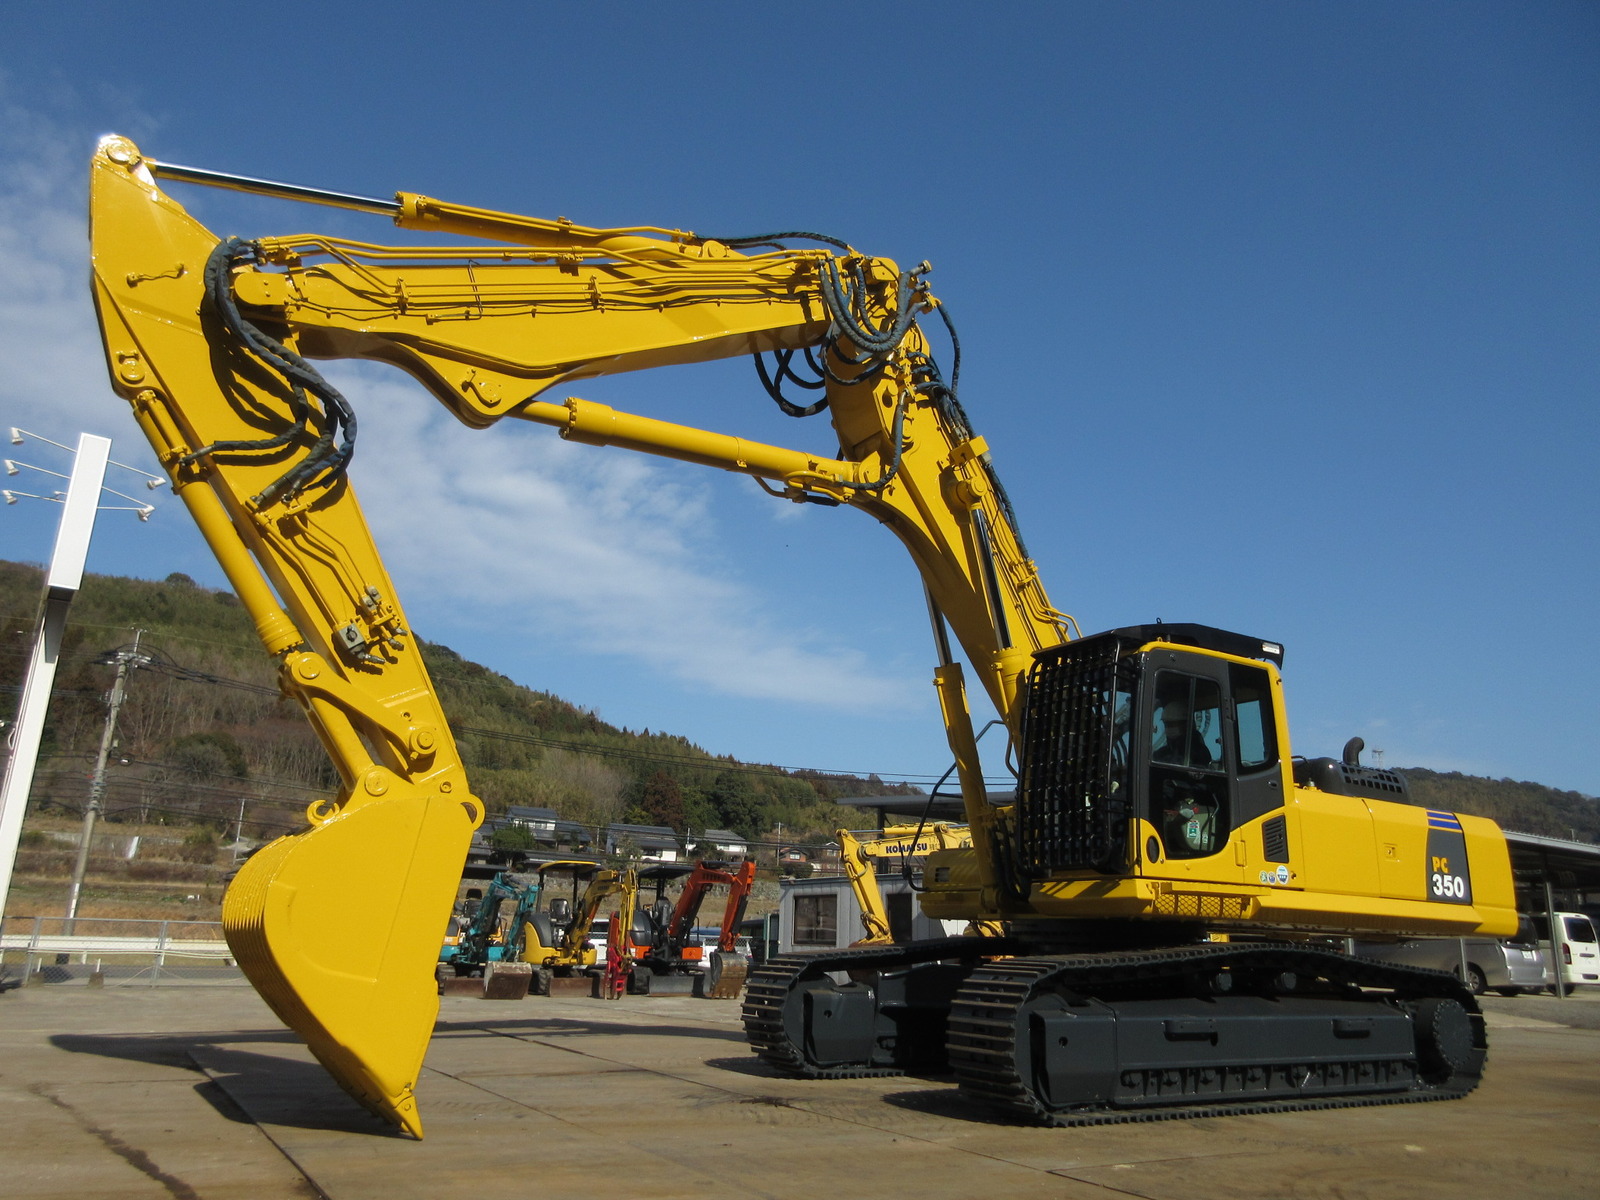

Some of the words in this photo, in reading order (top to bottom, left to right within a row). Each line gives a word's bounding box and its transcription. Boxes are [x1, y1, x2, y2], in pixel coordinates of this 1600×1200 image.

[886, 843, 927, 854] KOMASU
[1431, 856, 1449, 873] PC
[1432, 873, 1464, 898] 350
